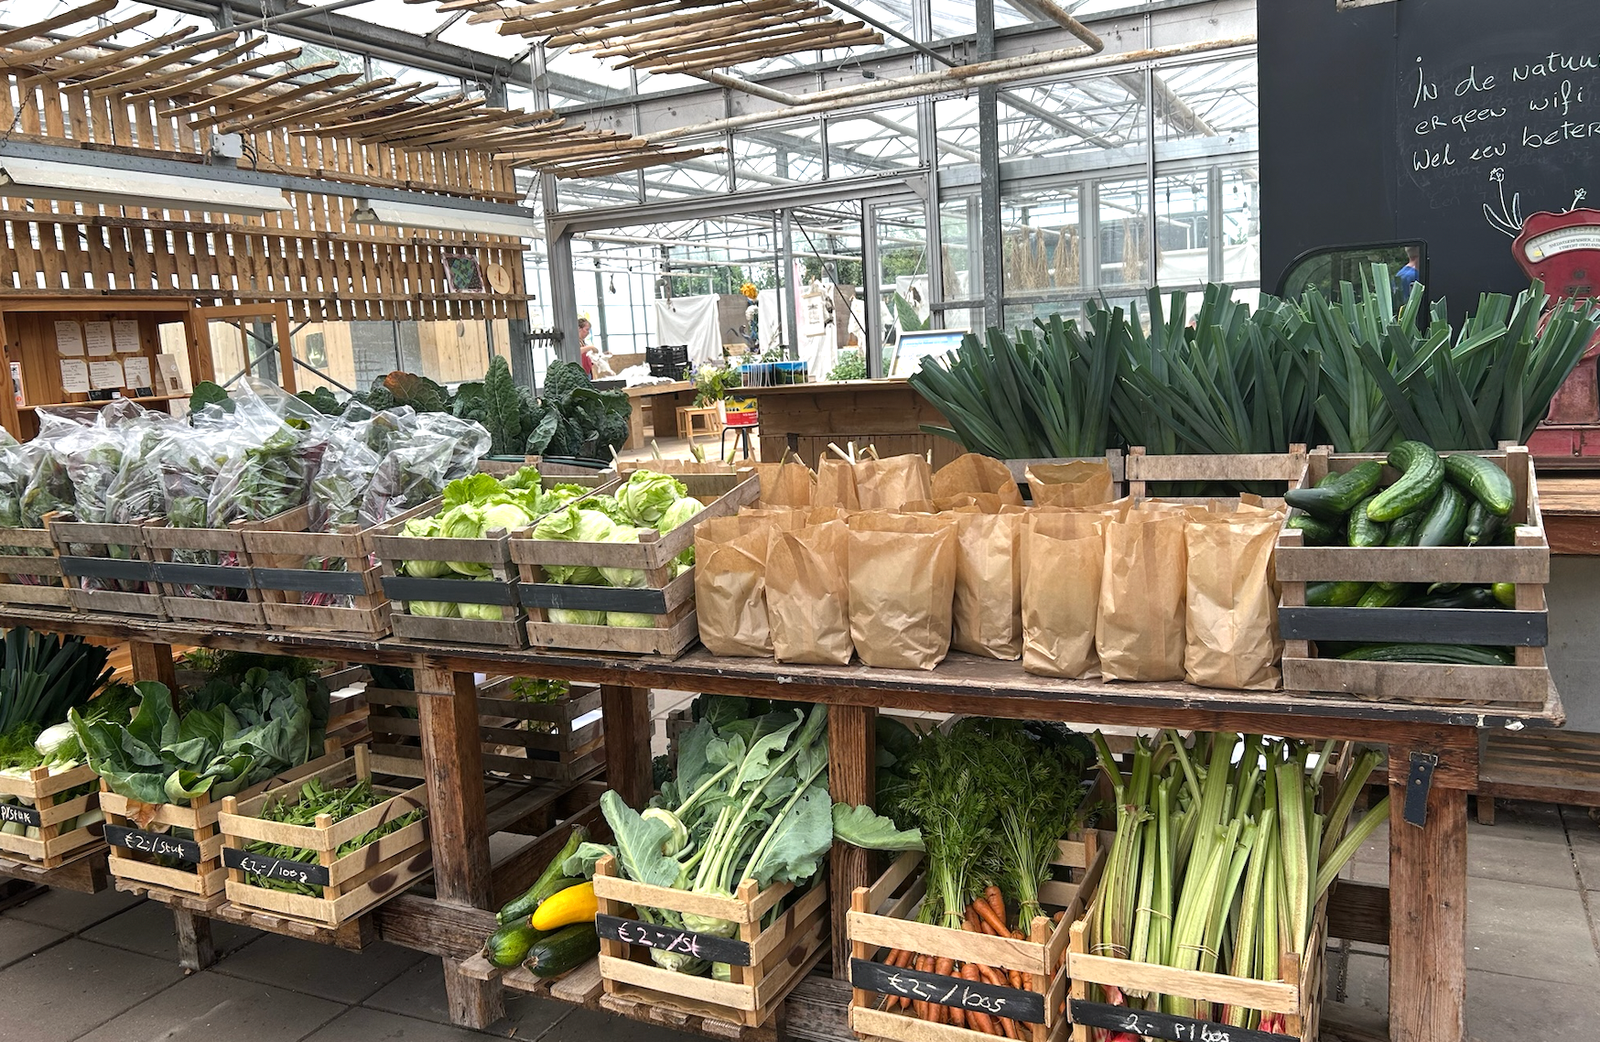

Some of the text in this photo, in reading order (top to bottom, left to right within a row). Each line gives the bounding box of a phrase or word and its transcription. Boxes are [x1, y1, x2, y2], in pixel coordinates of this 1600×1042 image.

[1455, 66, 1496, 96] de
[1530, 80, 1584, 116] wifi
[1413, 143, 1456, 171] Wel
